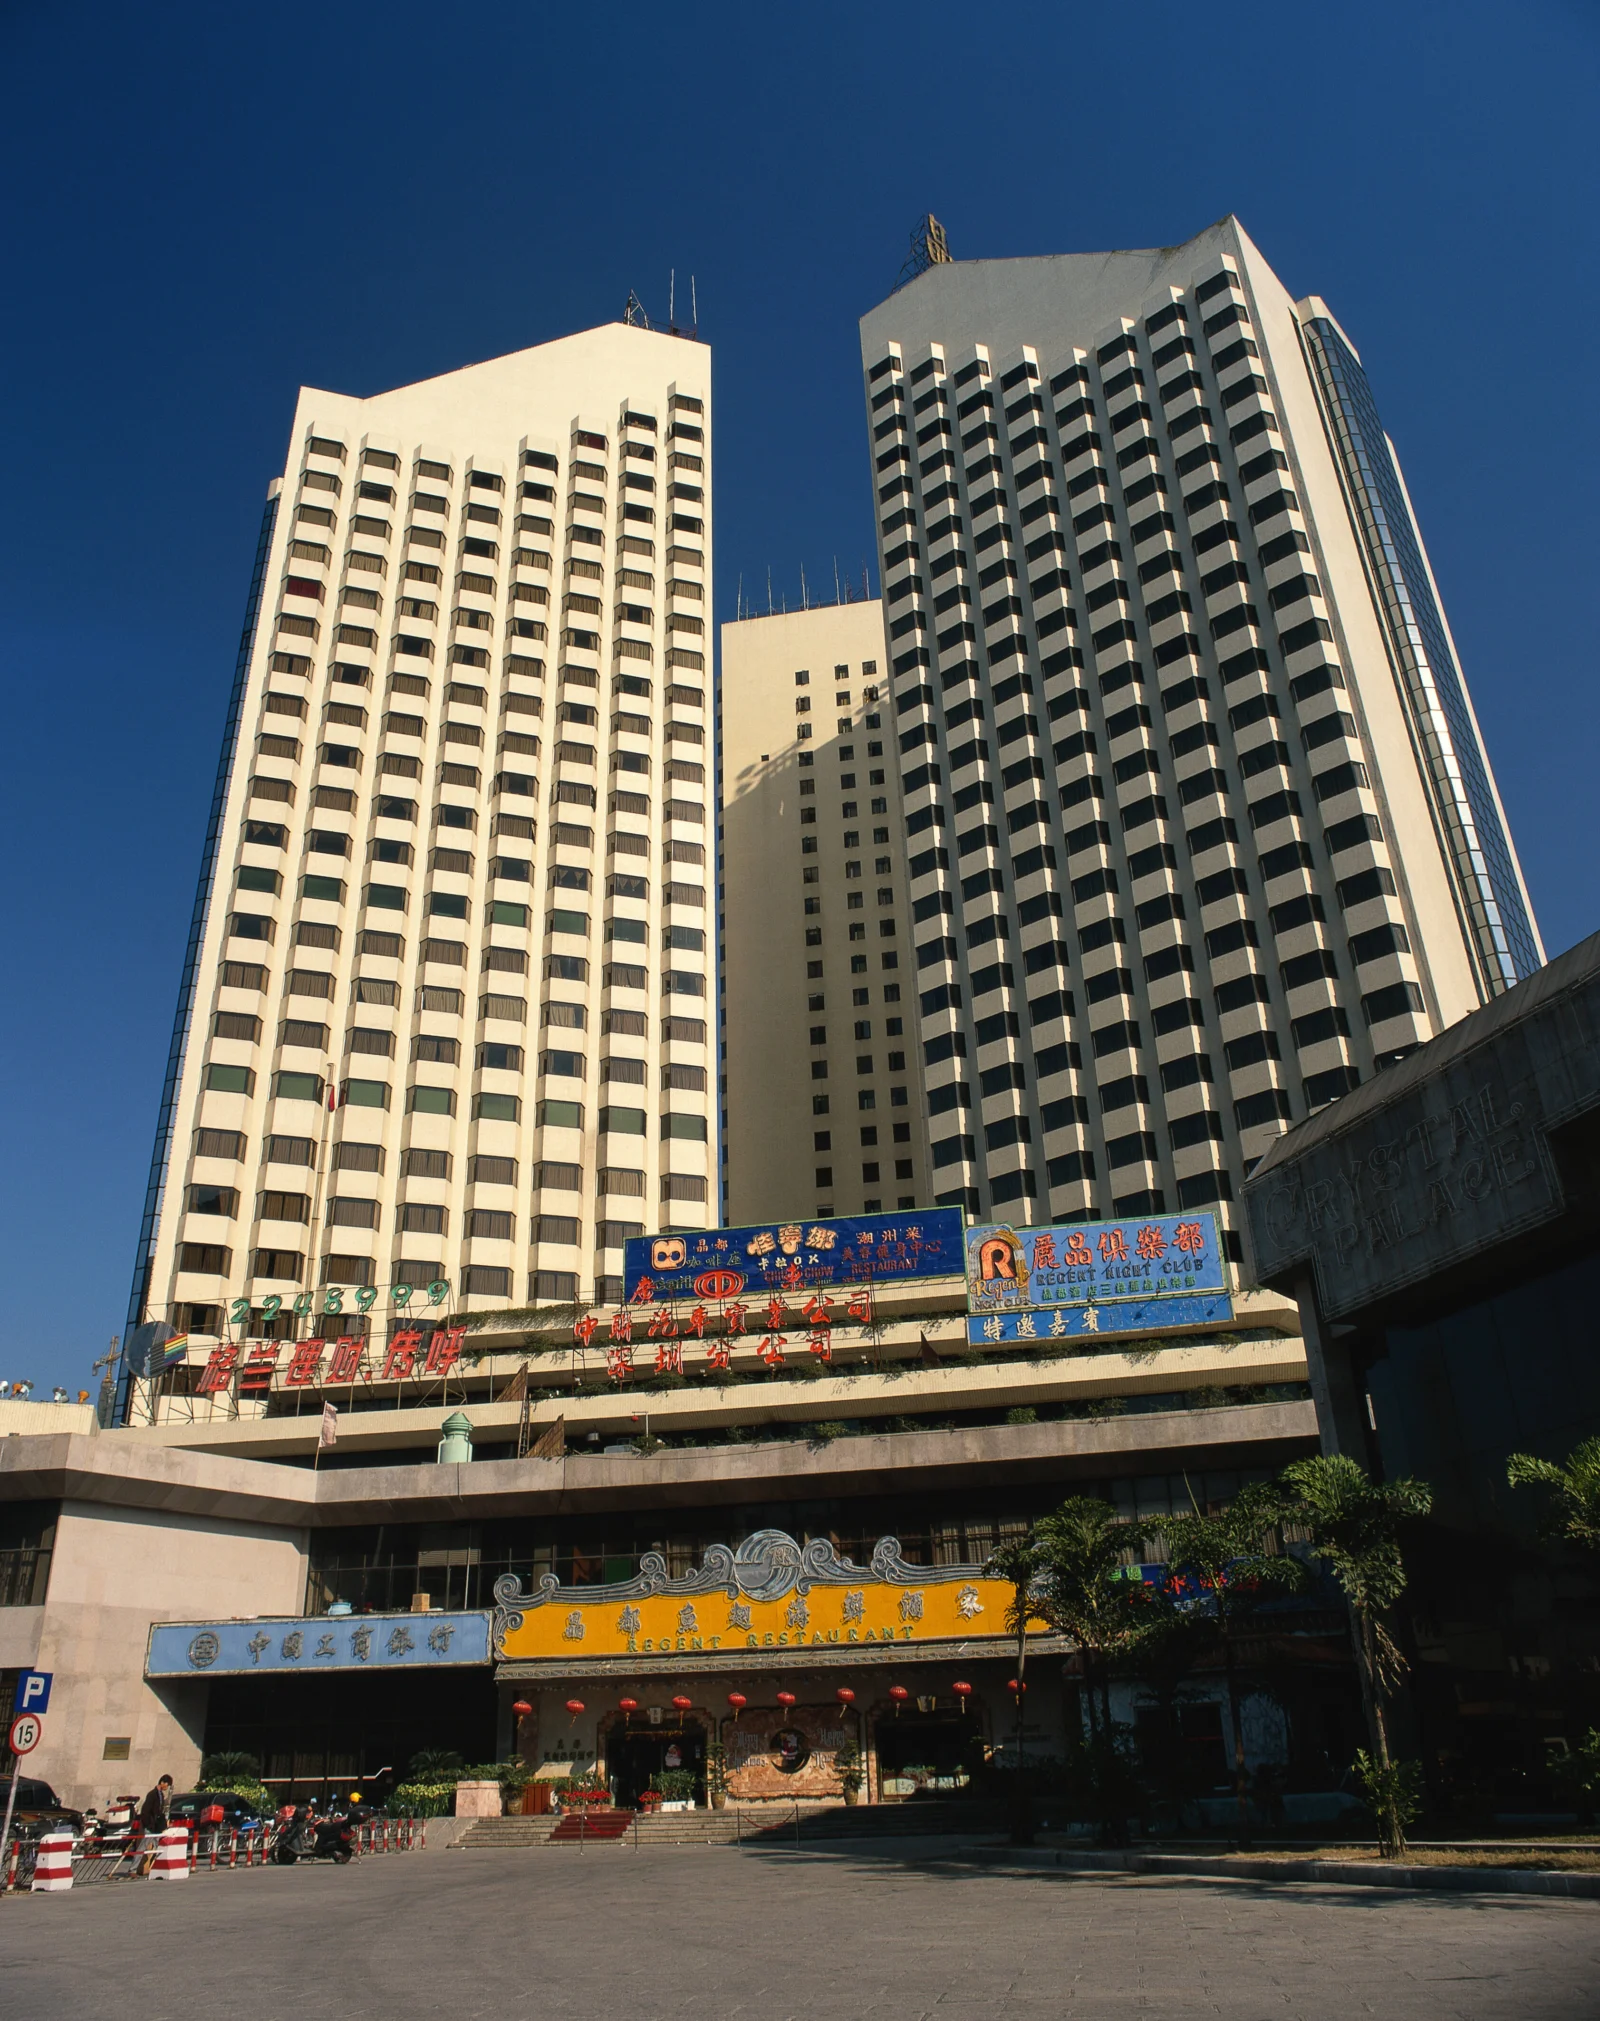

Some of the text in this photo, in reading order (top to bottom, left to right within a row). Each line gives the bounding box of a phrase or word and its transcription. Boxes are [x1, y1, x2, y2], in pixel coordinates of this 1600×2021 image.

[1264, 1082, 1525, 1251] CRYSTAL
[1332, 1134, 1536, 1267] PALACE
[855, 1226, 922, 1245] 潮州菜
[842, 1240, 942, 1262] 美容健身中心
[981, 1239, 1015, 1280] R
[804, 1266, 834, 1279] CHOW
[851, 1257, 918, 1274] RESTAURANT
[1036, 1259, 1203, 1286] REGENT NIGHT CLUB
[970, 1269, 1030, 1300] Regent
[231, 1278, 450, 1324] 2248999
[628, 1624, 914, 1652] REGENT RESTAURANT
[22, 1676, 45, 1708] P
[18, 1725, 34, 1745] 15
